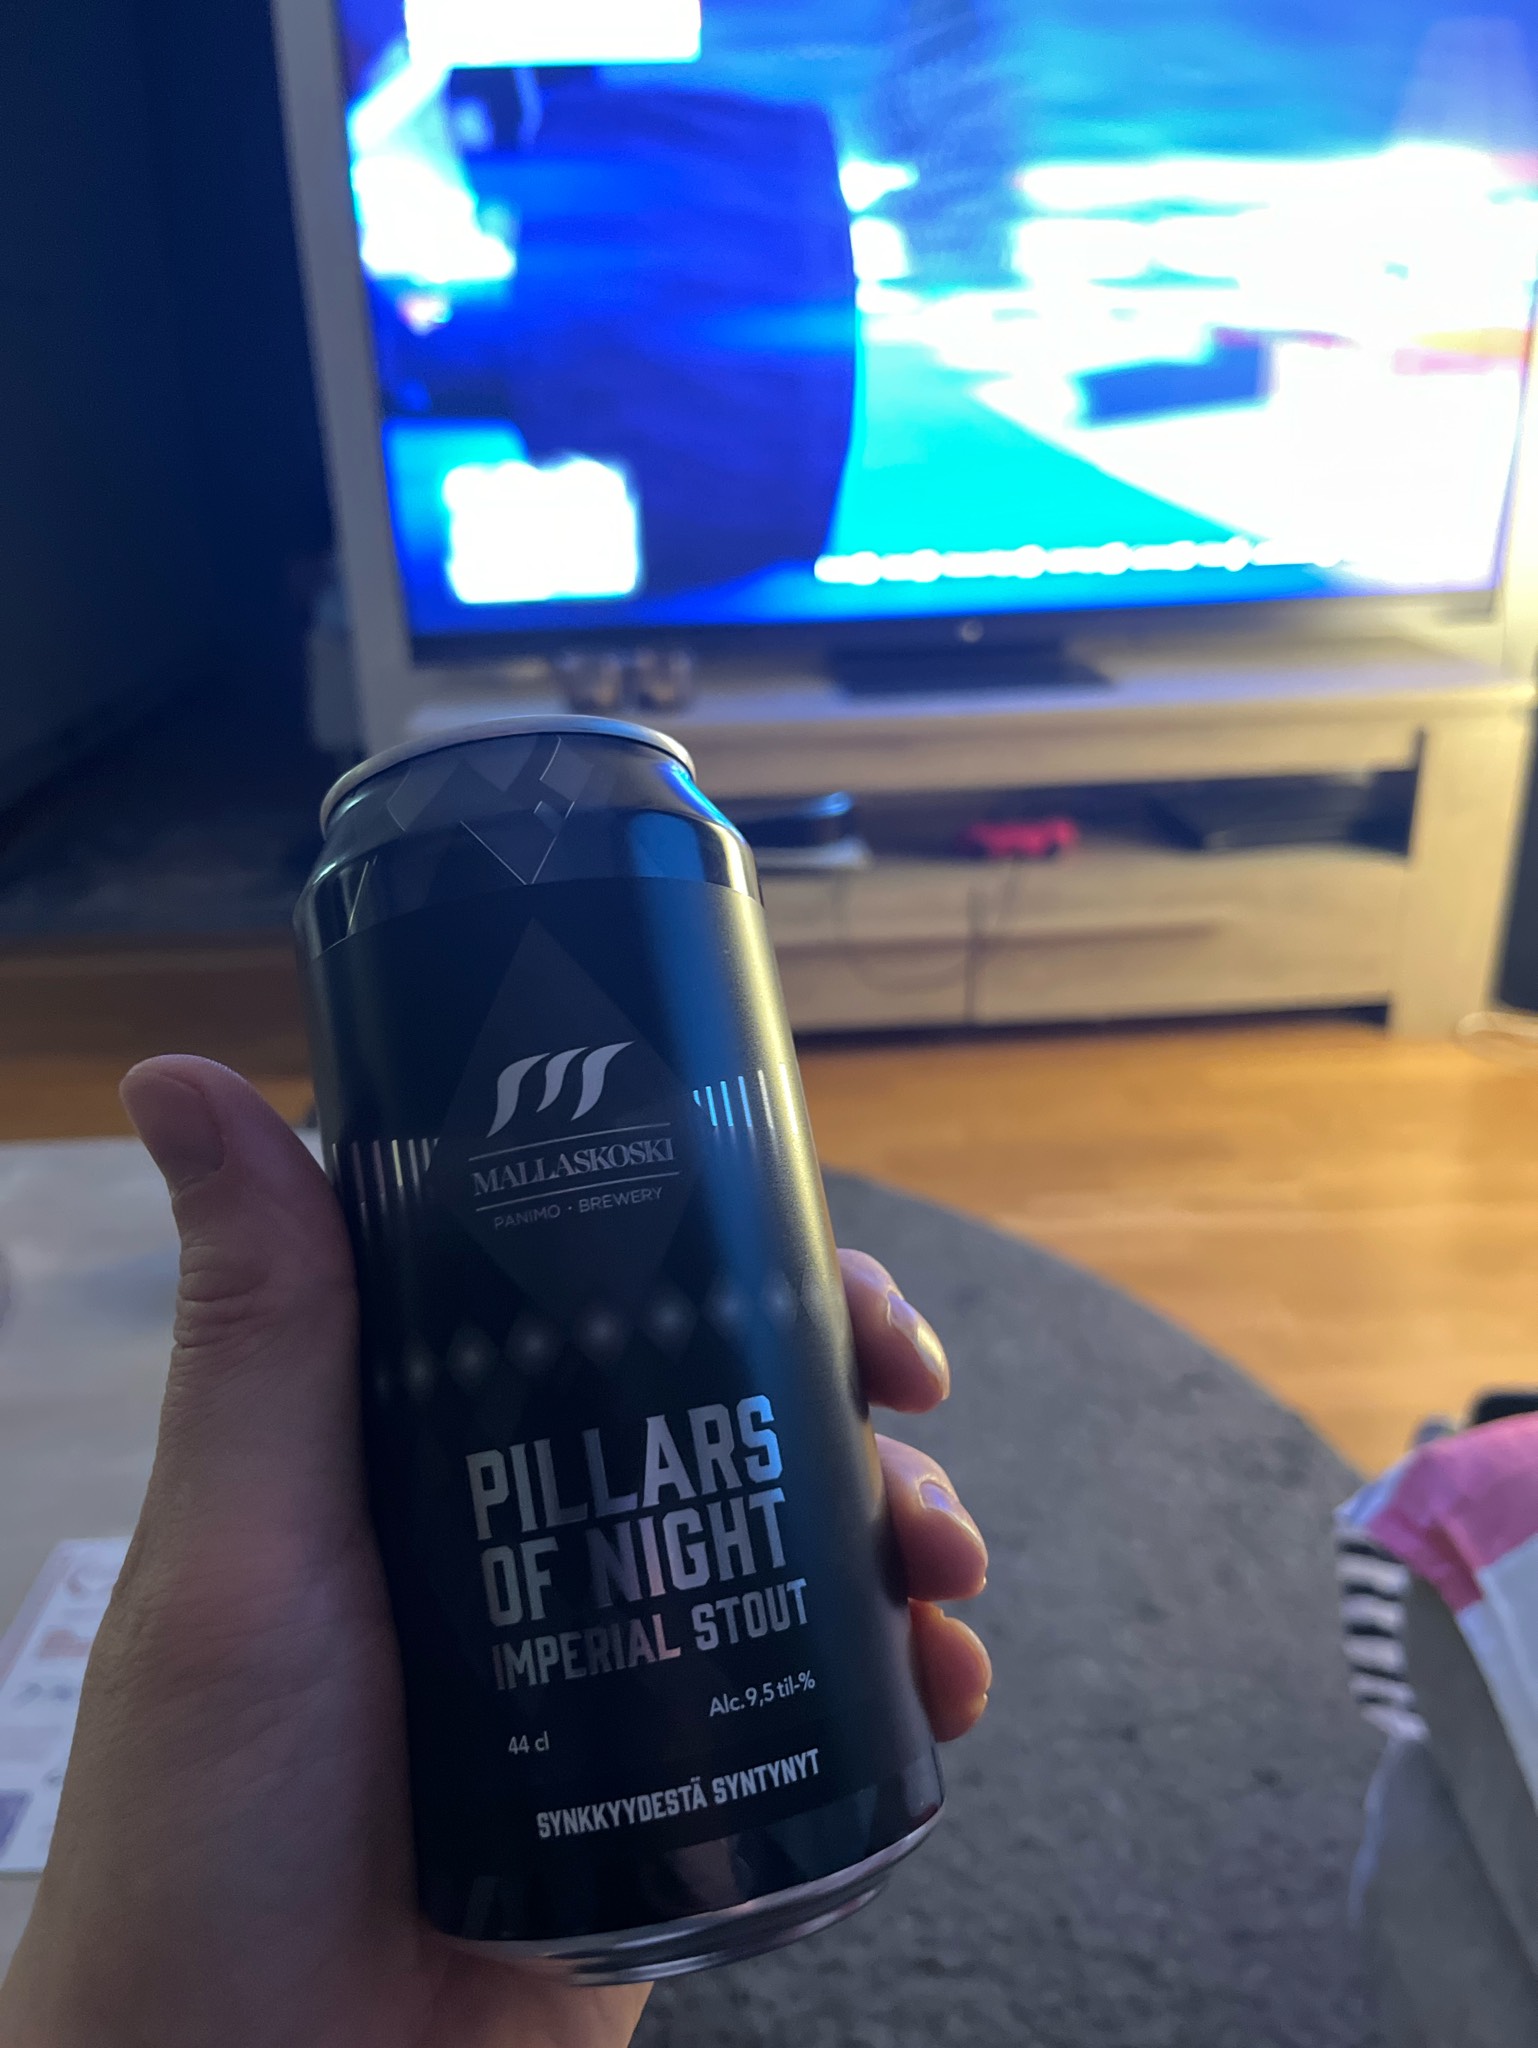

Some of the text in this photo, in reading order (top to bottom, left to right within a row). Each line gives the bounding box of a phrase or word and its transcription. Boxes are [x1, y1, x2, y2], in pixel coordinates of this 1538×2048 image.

[471, 1138, 674, 1196] MALLASKOSKI
[494, 1187, 662, 1230] PANIMO BREWERY
[465, 1393, 783, 1541] PILLARS
[480, 1487, 786, 1628] OF NIGHT
[491, 1577, 808, 1691] IMPERIAL STOUT
[507, 1730, 550, 1755] 44 cl
[535, 1748, 819, 1839] SYNKKYYDESTÄ SYNTYNYT
